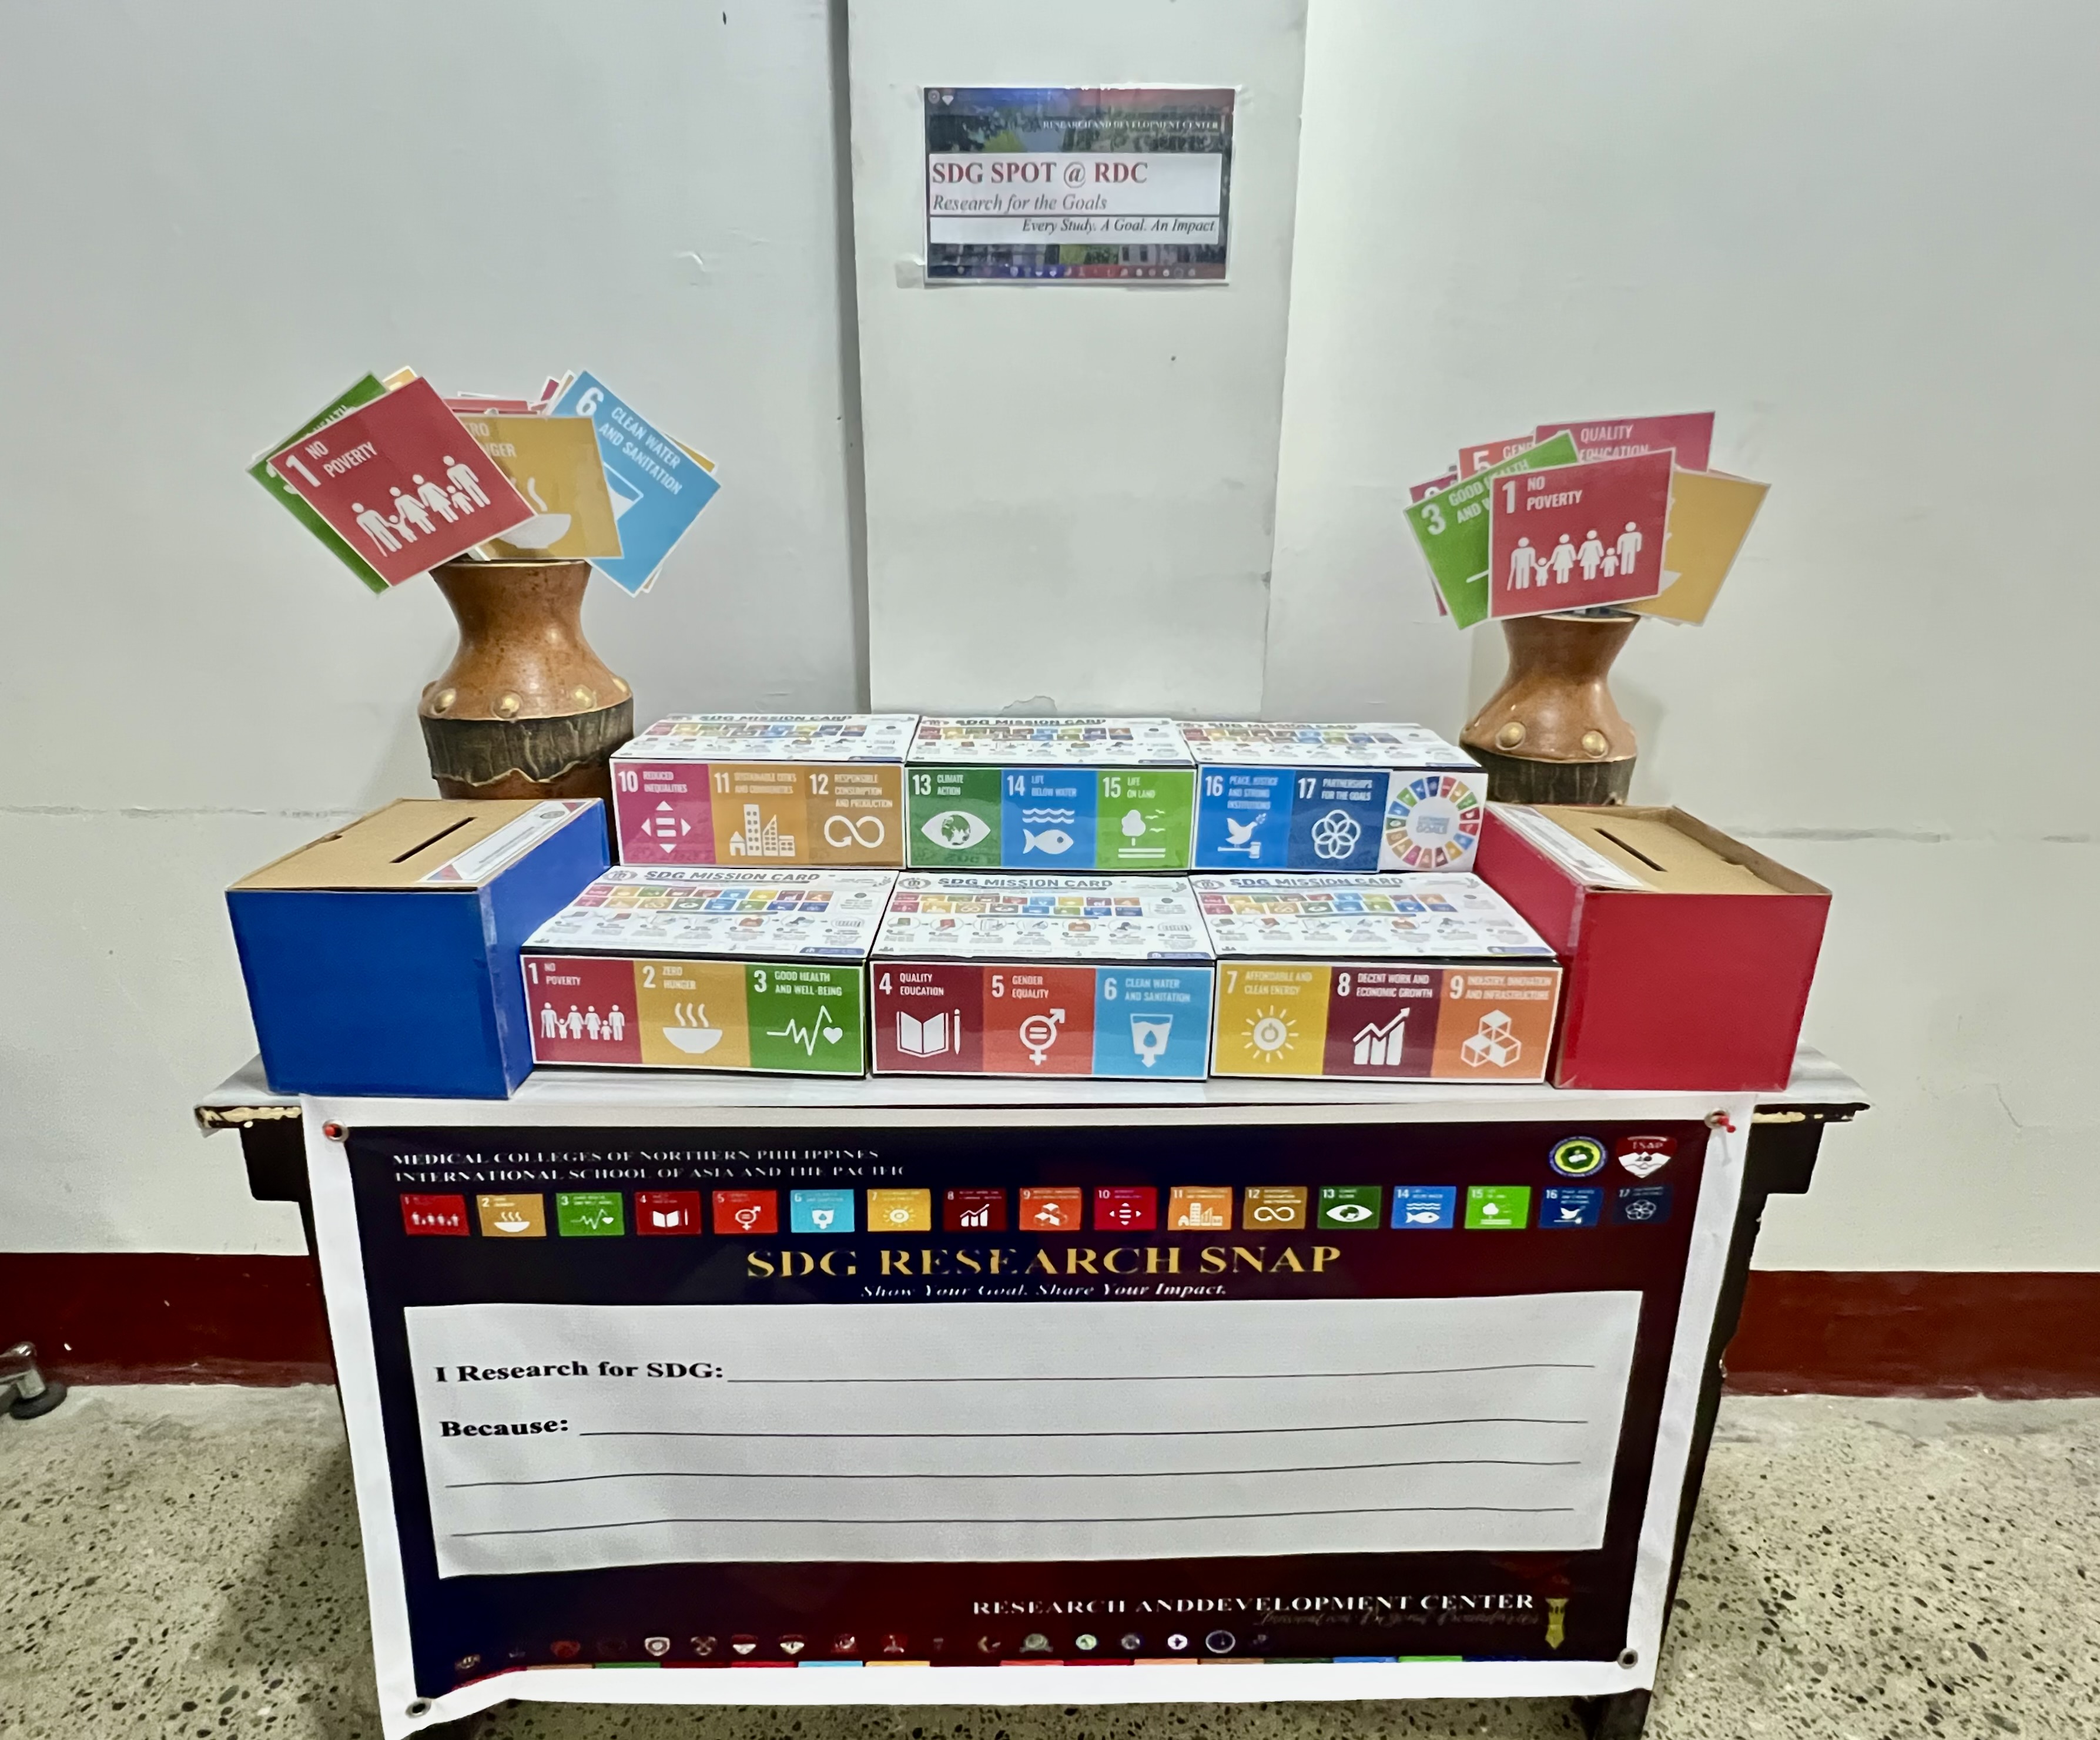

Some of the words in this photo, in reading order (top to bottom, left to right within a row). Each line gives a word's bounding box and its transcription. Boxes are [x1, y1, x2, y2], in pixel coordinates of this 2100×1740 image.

[932, 162, 983, 183] SDG
[991, 162, 1057, 183] SPOT
[1063, 162, 1086, 188] @
[1094, 162, 1148, 183] RDC
[933, 194, 1002, 210] Research
[1003, 194, 1030, 214] for
[1034, 194, 1056, 210] the
[1063, 194, 1107, 210] Goals
[1022, 219, 1058, 234] Every
[1060, 219, 1096, 234] Study.
[1100, 220, 1110, 232] A
[1114, 219, 1147, 232] Goal.
[1151, 219, 1168, 232] An
[576, 387, 604, 416] 6
[611, 407, 647, 440] CLEAN
[645, 434, 681, 469] WATER
[1580, 425, 1634, 442] QUALITY
[305, 441, 329, 460] NO
[599, 423, 624, 446] AND
[622, 442, 682, 495] SANITATION
[1579, 445, 1649, 462] EDUCATION
[323, 441, 377, 478] POVERTY
[1473, 450, 1491, 471] 5
[286, 455, 321, 487] 1
[1528, 476, 1545, 491] NO
[1448, 481, 1484, 506] GOOD
[1502, 480, 1515, 514] 1
[1526, 490, 1582, 511] POVERTY
[1421, 504, 1446, 535] 3
[1457, 503, 1482, 524] AND
[618, 771, 639, 793] 10
[714, 772, 730, 793] 11
[809, 773, 829, 794] 12
[912, 774, 932, 796] 13
[937, 775, 964, 784] CLIMATE
[1007, 775, 1025, 796] 14
[1103, 777, 1121, 798] 15
[1205, 776, 1224, 797] 16
[937, 787, 960, 796] ACTION
[1298, 778, 1317, 799] 17
[644, 871, 686, 880] SDG
[690, 872, 766, 881] MISSION
[938, 878, 979, 886] SDG
[984, 879, 1059, 887] MISSION
[1230, 878, 1270, 887] SDG
[1274, 878, 1350, 887] MISSION
[1355, 877, 1403, 886] CARD
[528, 963, 538, 984] 1
[546, 975, 581, 985] POVERTY
[642, 965, 656, 988] 2
[754, 970, 767, 993] 3
[775, 971, 797, 981] GOOD
[799, 971, 830, 982] HEALTH
[900, 973, 933, 983] QUALITY
[1012, 975, 1043, 985] GENDER
[1227, 970, 1238, 994] 7
[1295, 972, 1312, 982] AND
[1357, 973, 1386, 983] DECENT
[1412, 974, 1429, 984] AND
[775, 985, 792, 994] AND
[794, 985, 842, 996] WELL-BEING
[879, 972, 892, 995] 4
[900, 986, 944, 996] EDUCATION
[992, 975, 1004, 997] 5
[1104, 977, 1117, 1001] 6
[1126, 978, 1151, 988] CLEAN
[1153, 978, 1180, 988] WATER
[1337, 973, 1351, 996] 8
[1450, 975, 1464, 999] 9
[1012, 988, 1049, 999] EQUALITY
[1124, 991, 1142, 1001] AND
[1144, 991, 1190, 1002] SANITATION
[1357, 987, 1396, 997] ECONOMIC
[1398, 988, 1433, 998] GROWTH
[393, 1152, 489, 1165] MEDICAL
[493, 1151, 602, 1164] COLLEGES
[607, 1151, 634, 1162] OF
[640, 1150, 750, 1161] NORTHERN
[757, 1150, 879, 1160] PHILIPPINES
[395, 1169, 564, 1182] INTERNATIONAL
[569, 1168, 651, 1179] SCHOOL
[657, 1167, 684, 1178] OF
[692, 1167, 735, 1178] ASIA
[745, 1167, 782, 1177] AND
[833, 1166, 906, 1176] PACIFIC
[561, 1196, 570, 1205] 3
[640, 1194, 647, 1203] 4
[717, 1193, 724, 1203] 5
[794, 1192, 802, 1202] 6
[947, 1191, 954, 1200] 8
[1023, 1190, 1030, 1199] 9
[1098, 1189, 1110, 1199] 10
[1173, 1189, 1183, 1198] 11
[1248, 1189, 1260, 1199] 12
[1322, 1188, 1335, 1198] 13
[1396, 1189, 1409, 1199] 14
[1471, 1189, 1483, 1199] 15
[1546, 1189, 1558, 1199] 16
[482, 1198, 490, 1207] 2
[746, 1249, 858, 1278] SDG
[880, 1246, 1181, 1276] RESEARCH
[1200, 1246, 1341, 1273] SNAP
[861, 1285, 913, 1297] Show
[926, 1285, 970, 1296] Your
[1036, 1284, 1094, 1296] Share
[1104, 1283, 1149, 1296] Your
[1155, 1283, 1226, 1298] Impact.
[436, 1366, 448, 1383] I
[457, 1361, 588, 1382] Research
[598, 1361, 638, 1377] for
[647, 1362, 723, 1378] SDG:
[440, 1419, 568, 1437] Because:
[973, 1599, 1124, 1614] RESEARCH
[1420, 1594, 1533, 1609] CENTER
